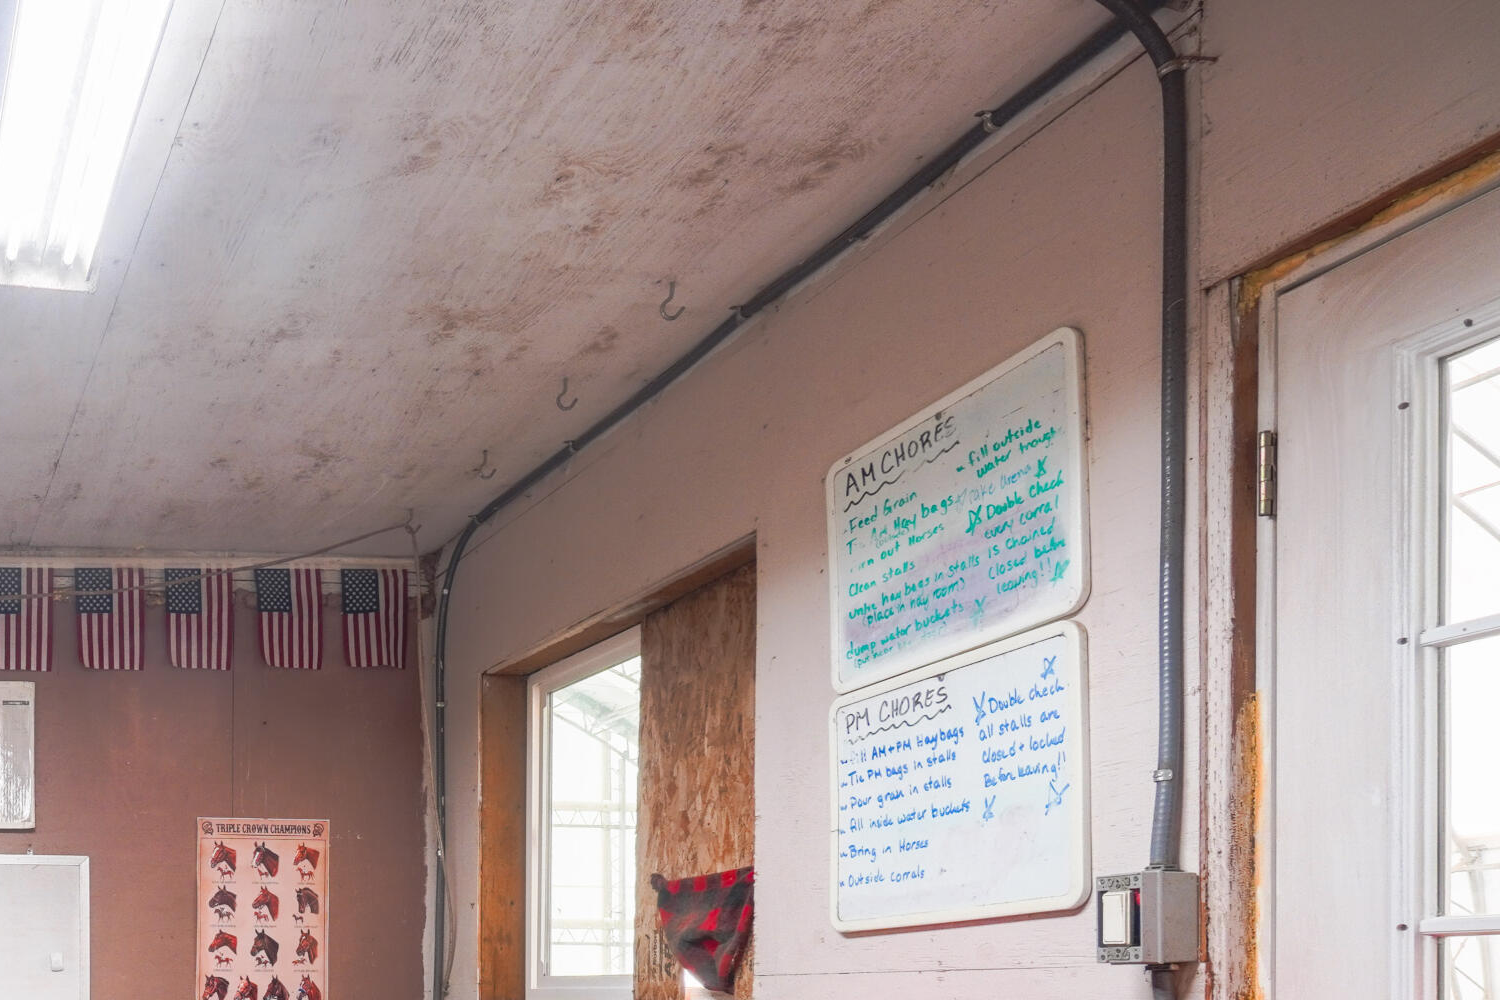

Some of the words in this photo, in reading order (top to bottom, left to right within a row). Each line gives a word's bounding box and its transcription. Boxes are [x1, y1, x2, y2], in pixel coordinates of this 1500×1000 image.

[845, 462, 875, 496] AM
[880, 416, 957, 474] CHORES
[987, 491, 1024, 519] Double
[849, 505, 878, 533] Feed
[845, 710, 871, 734] PM
[879, 686, 948, 722] CHORES
[988, 692, 1024, 714] Double
[979, 725, 993, 742] all
[998, 713, 1032, 735] stalls
[926, 750, 957, 768] stalls
[923, 775, 952, 792] stalls
[216, 824, 240, 833] TRIPLE
[242, 824, 269, 833] CROWN
[270, 824, 311, 834] CHAMPIONS
[848, 844, 877, 863] Bring
[882, 843, 891, 853] in
[900, 838, 929, 852] Horses
